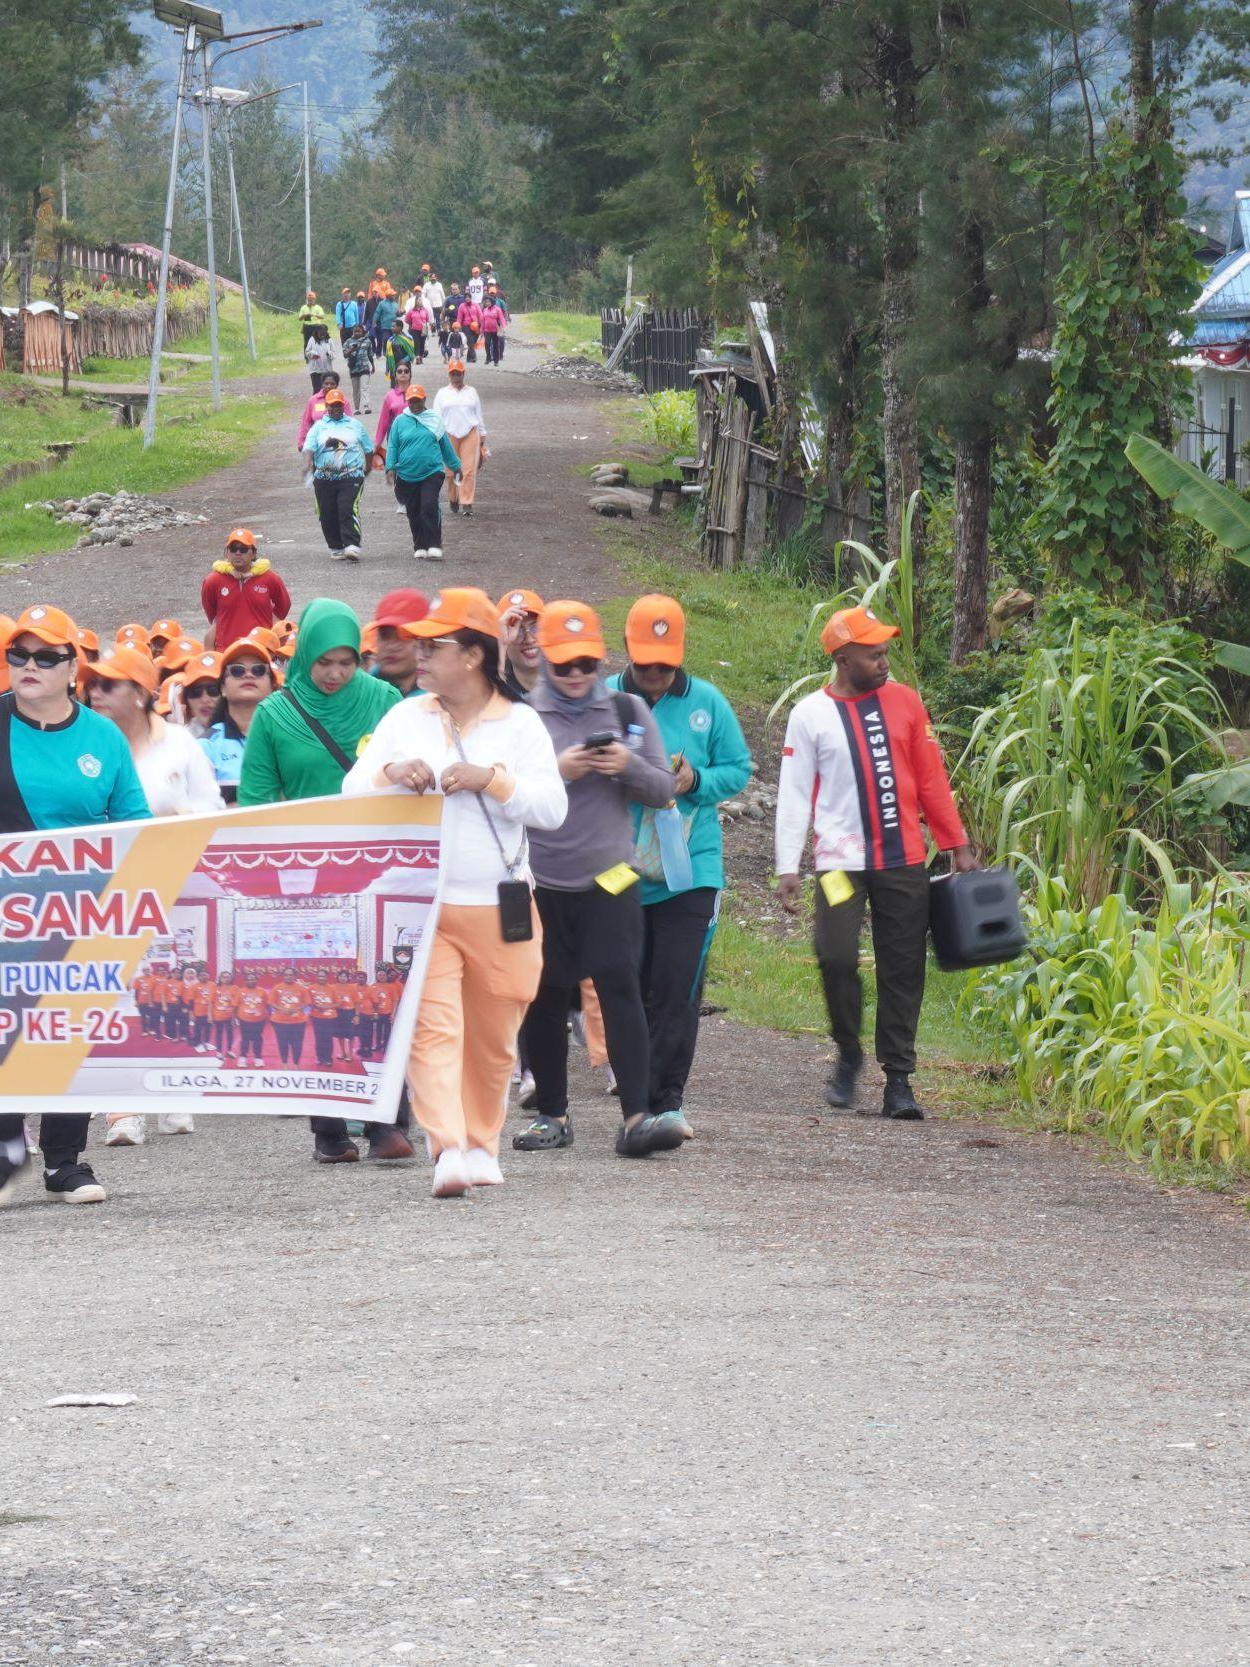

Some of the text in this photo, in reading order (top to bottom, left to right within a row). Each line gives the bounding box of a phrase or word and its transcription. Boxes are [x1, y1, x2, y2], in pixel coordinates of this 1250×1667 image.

[864, 710, 899, 829] INDONESIA
[5, 962, 122, 993] PUNCAK
[25, 1009, 124, 1041] KE-26
[161, 1074, 228, 1090] ILAGA,
[234, 1075, 255, 1088] 27
[261, 1075, 367, 1095] NOVEMBER
